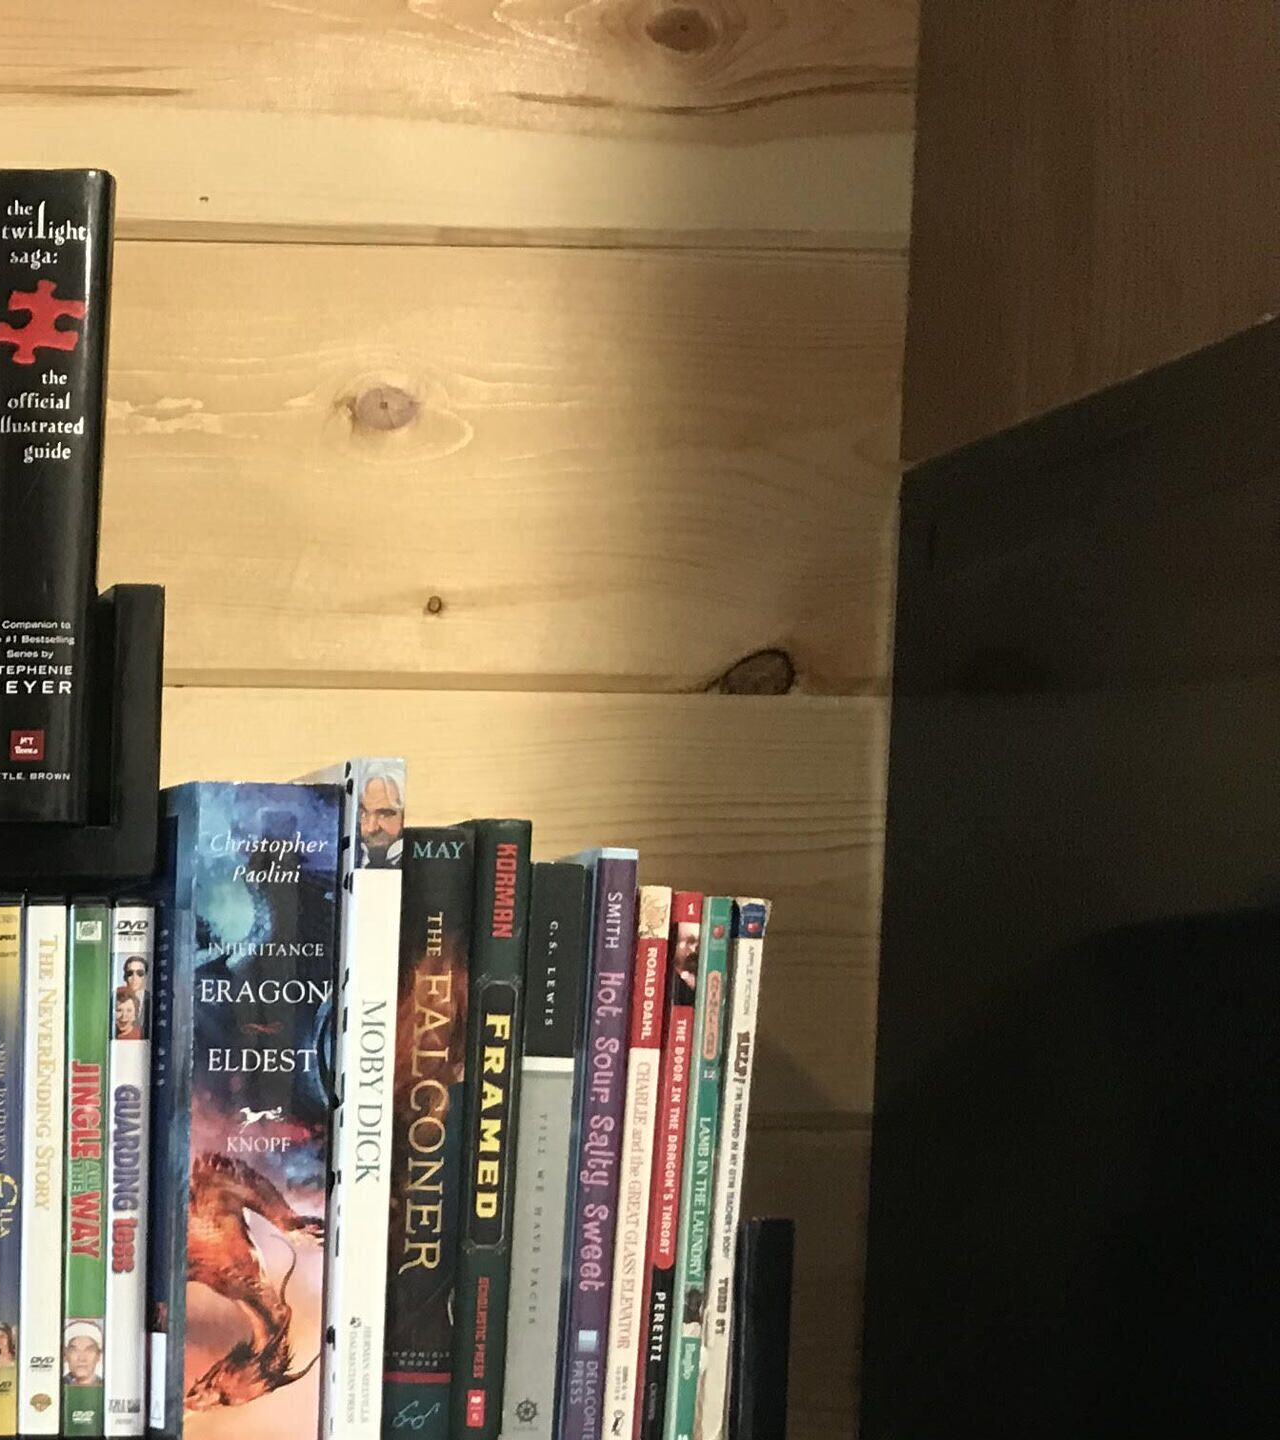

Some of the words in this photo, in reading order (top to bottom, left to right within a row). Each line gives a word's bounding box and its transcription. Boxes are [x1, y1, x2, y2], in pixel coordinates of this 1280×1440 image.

[1, 200, 87, 246] twilight
[7, 200, 33, 217] the
[10, 250, 58, 269] saga:
[42, 371, 67, 385] the
[7, 392, 70, 410] official
[24, 443, 71, 463] guide
[2, 620, 57, 632] Companion
[60, 621, 71, 629] to
[6, 635, 17, 644] #1
[21, 634, 75, 646] Bestselling
[41, 649, 53, 661] by
[210, 832, 328, 861] Christopher
[412, 841, 465, 859] MAY
[233, 865, 300, 885] Paolini
[492, 844, 518, 938] KORMAN
[117, 920, 148, 931] DVD
[426, 912, 444, 956] THE
[605, 892, 623, 949] SMITH
[39, 936, 58, 980] THE
[209, 943, 324, 957] INHERITANCE
[643, 946, 658, 998] ROALD
[201, 978, 331, 1003] ERAGON
[545, 967, 556, 1026] LEWIS
[595, 972, 625, 1026] Hot,
[640, 1000, 655, 1040] DAHL
[676, 1019, 686, 1042] THE
[208, 1049, 317, 1072] ELDEST
[359, 1000, 387, 1095] MOBY
[674, 1046, 684, 1084] DOOR
[590, 1038, 619, 1103] Sour,
[71, 1060, 101, 1160] JINGLE
[398, 966, 452, 1275] FALCONER
[475, 1013, 511, 1218] FRAMED
[669, 1106, 680, 1130] THE
[113, 1084, 141, 1211] GUARDING
[227, 1136, 291, 1152] KNOPF
[355, 1103, 383, 1183] DICK
[35, 1145, 54, 1211] STORY
[664, 1134, 678, 1200] DRAGON'S
[71, 1190, 101, 1259] WAY
[659, 1204, 672, 1255] THROAT
[579, 1203, 609, 1292] Sweet
[650, 1291, 666, 1362] PERETTI
[571, 1361, 582, 1404] PRESS
[583, 1361, 599, 1440] DELACORTE
